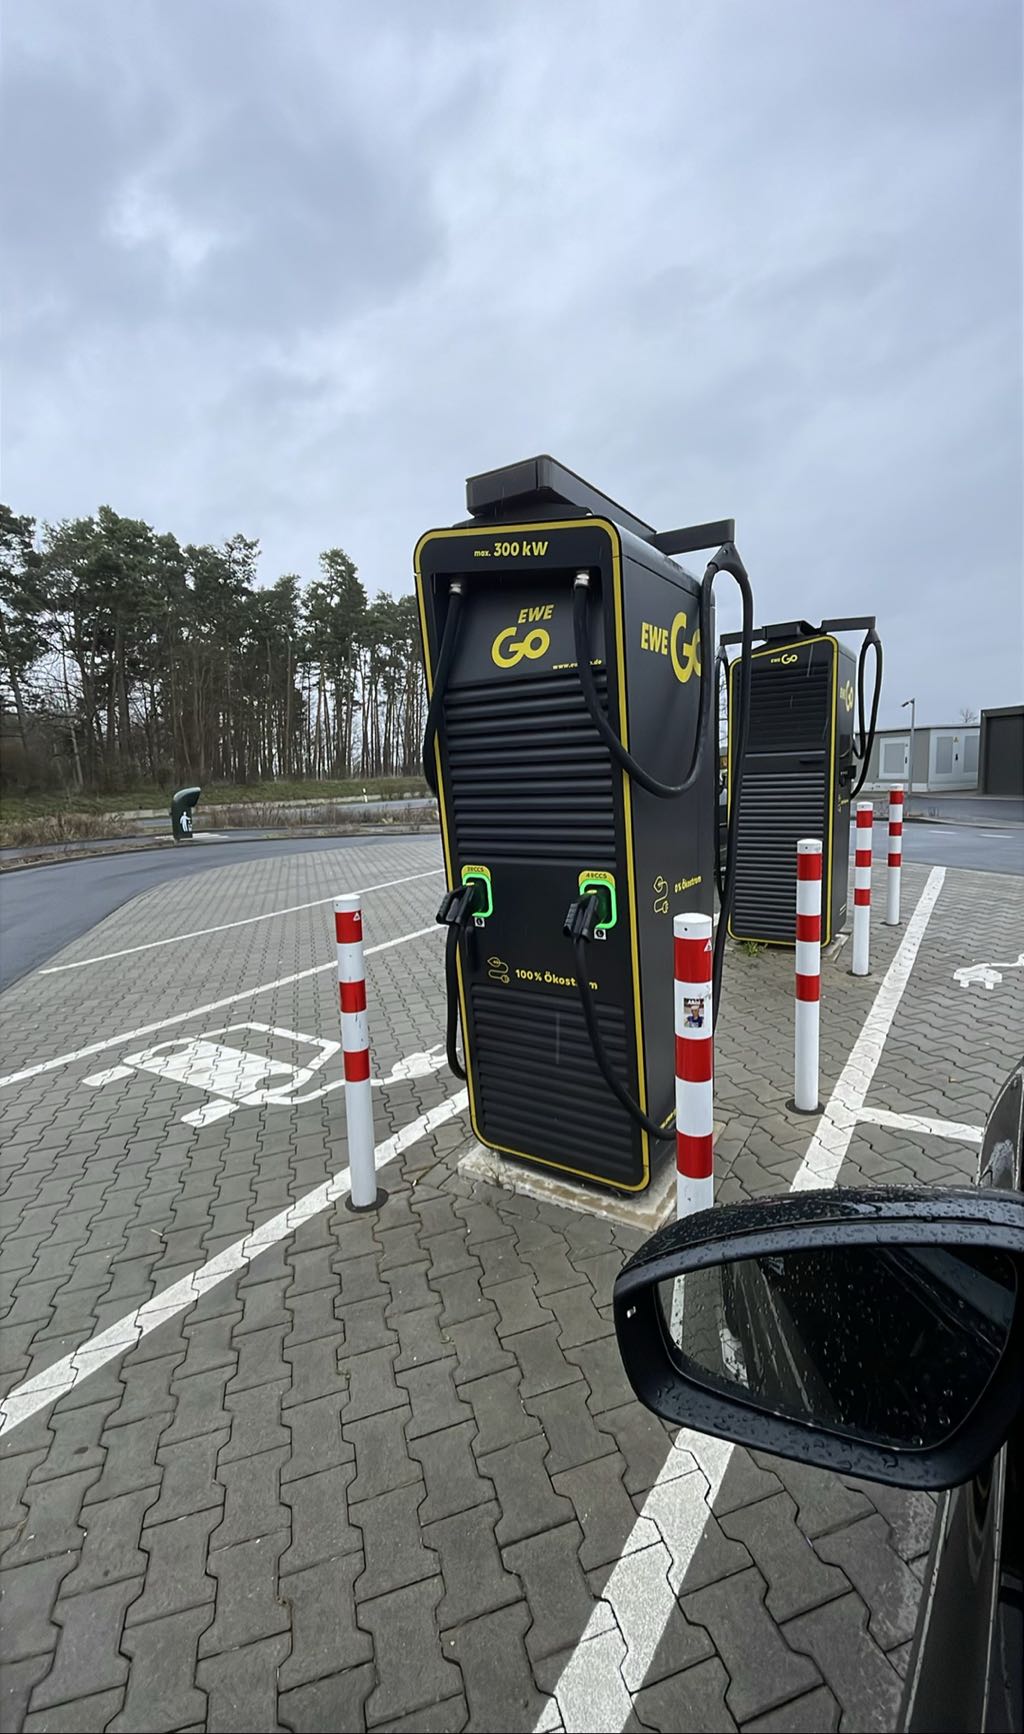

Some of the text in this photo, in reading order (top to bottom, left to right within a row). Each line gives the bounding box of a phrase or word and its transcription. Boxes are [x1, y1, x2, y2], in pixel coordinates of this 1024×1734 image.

[494, 542, 520, 557] 300
[522, 541, 549, 556] kW
[518, 604, 554, 624] EWE
[491, 626, 550, 669] Go
[641, 621, 669, 656] EWE
[515, 968, 599, 991] 100% Ökostm
